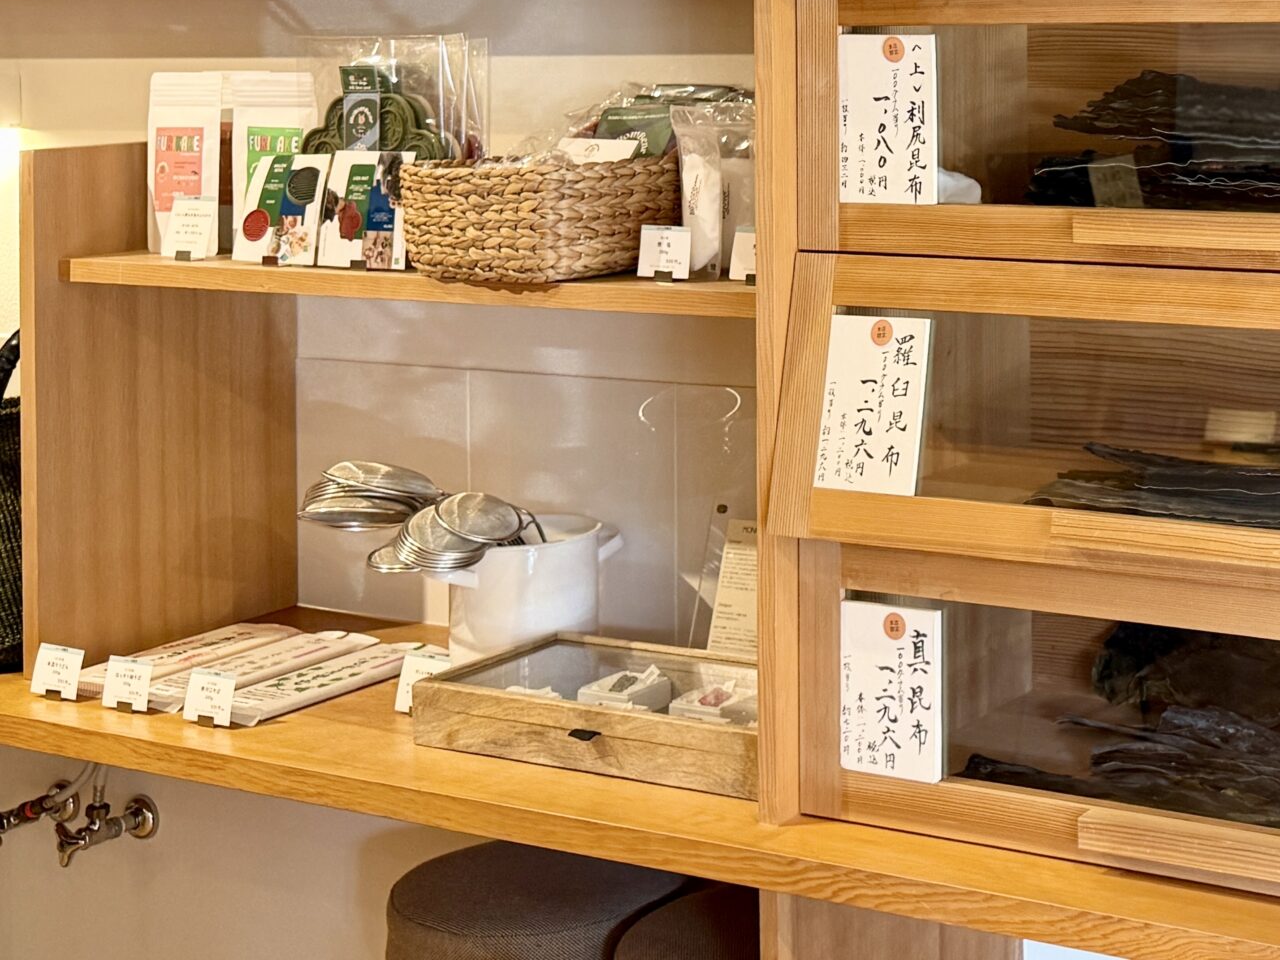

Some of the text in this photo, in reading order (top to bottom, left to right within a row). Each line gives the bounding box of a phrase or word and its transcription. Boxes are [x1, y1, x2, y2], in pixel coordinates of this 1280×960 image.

[248, 135, 300, 153] FURIAKE
[882, 334, 918, 478] 羅臼昆布
[907, 629, 932, 755] 真昆布
